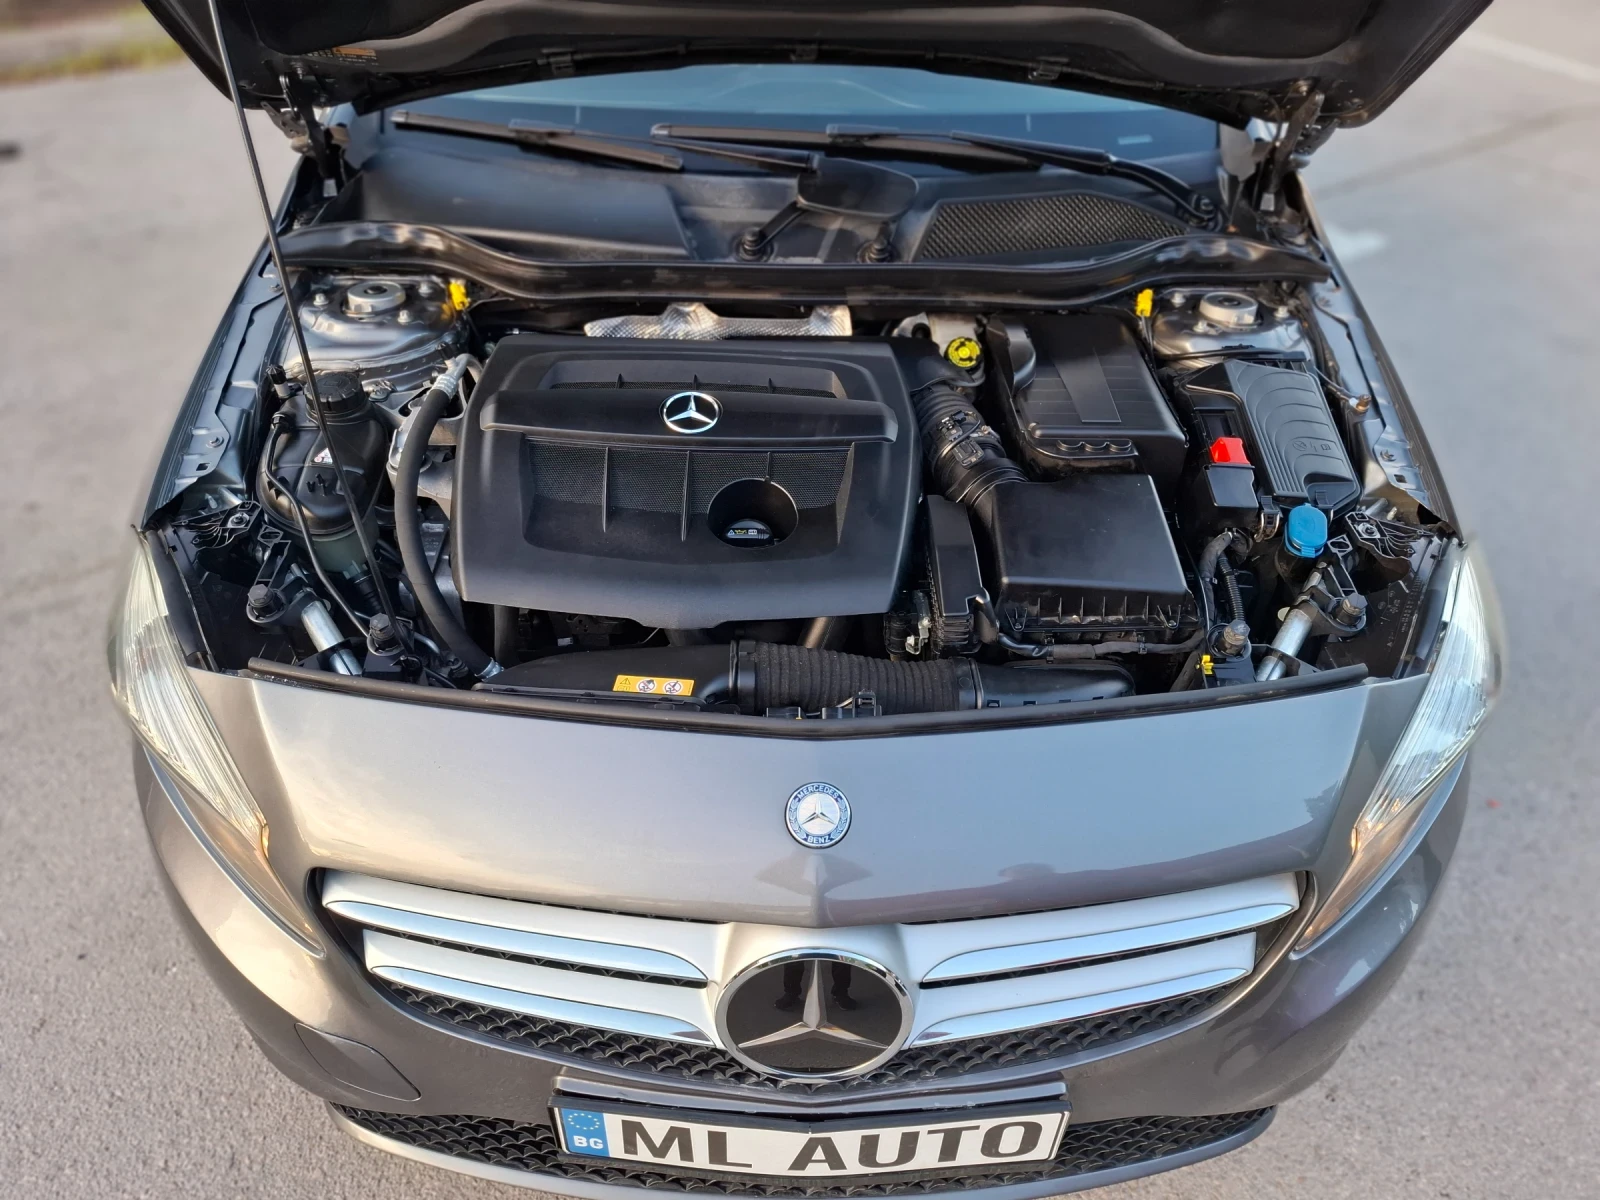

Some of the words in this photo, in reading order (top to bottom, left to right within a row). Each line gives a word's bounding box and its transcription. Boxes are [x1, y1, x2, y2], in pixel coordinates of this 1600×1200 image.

[797, 784, 839, 799] MERCEDES
[807, 835, 831, 843] BENZ
[573, 1135, 604, 1149] BG
[621, 1119, 752, 1168] ML
[787, 1121, 1043, 1171] AUTO
